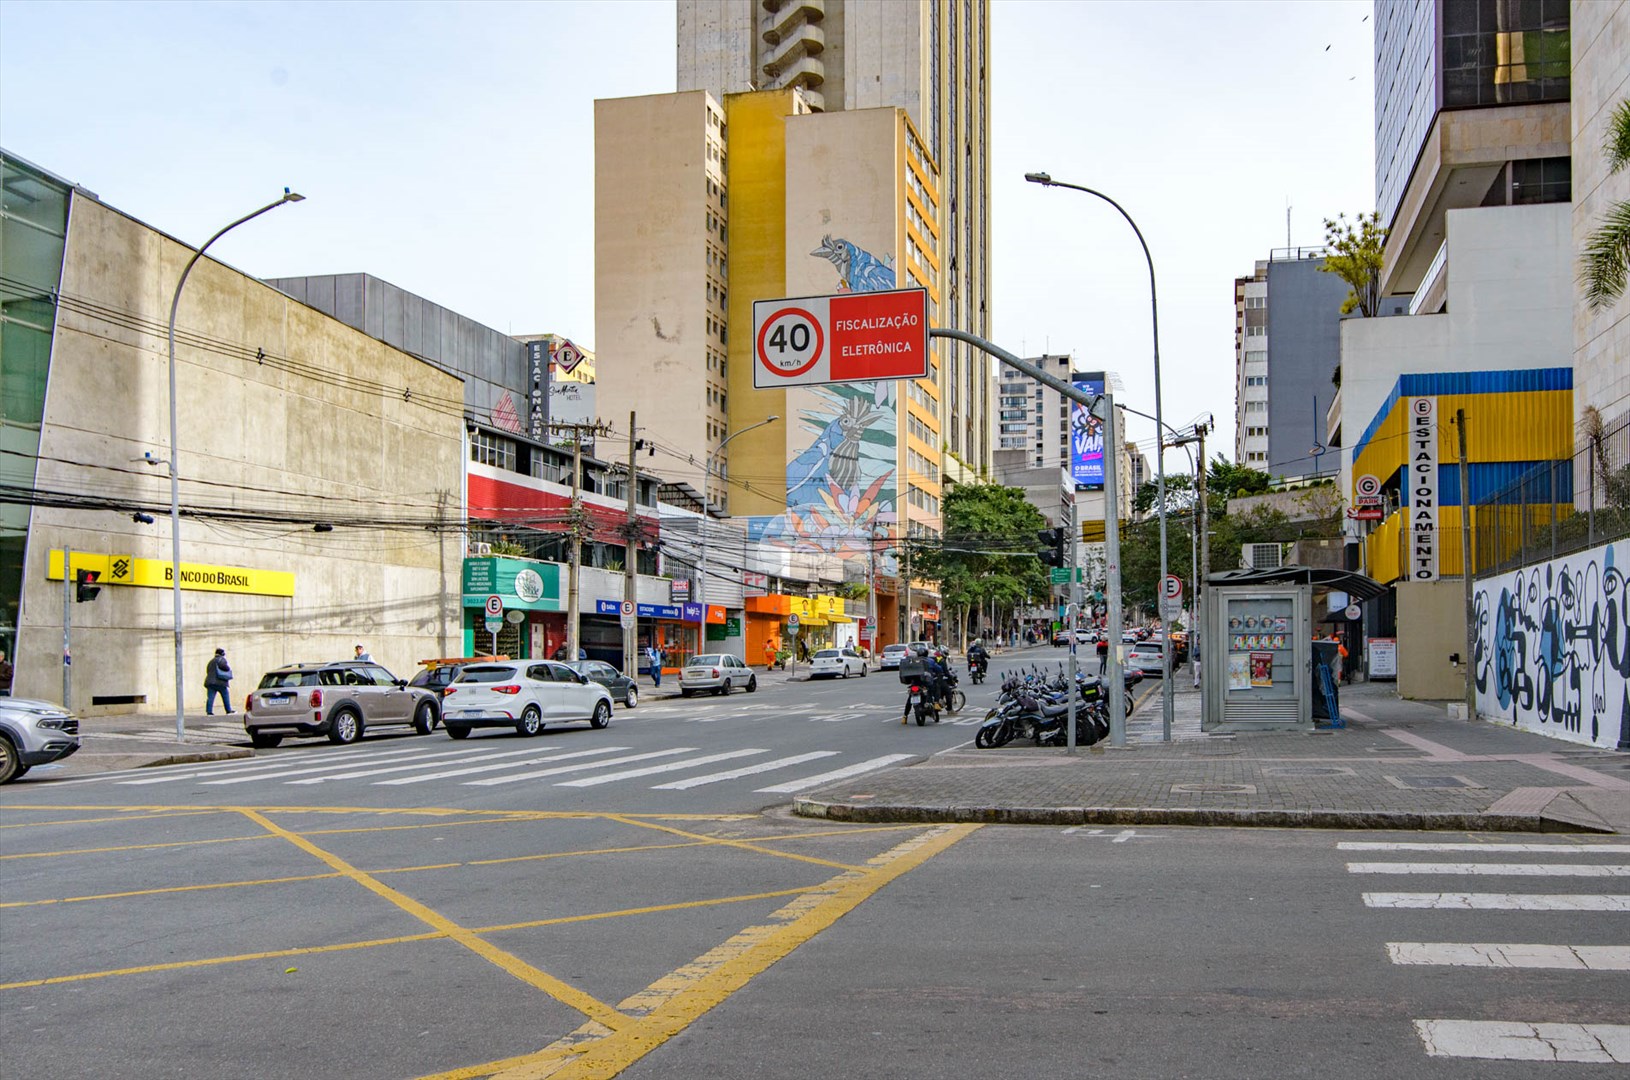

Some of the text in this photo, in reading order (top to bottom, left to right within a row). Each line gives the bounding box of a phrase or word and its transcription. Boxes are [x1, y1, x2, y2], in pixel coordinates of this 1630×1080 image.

[836, 312, 918, 331] FISCALIZAÇÃO
[769, 323, 810, 353] 40
[842, 340, 912, 357] ELETRÔNICA
[563, 350, 572, 361] E
[780, 358, 802, 367] km/h
[1418, 402, 1427, 412] E
[1362, 480, 1375, 492] G
[1415, 417, 1433, 579] ESTACIONAMENTO
[165, 567, 250, 587] BNCO DO BRASIL
[1167, 580, 1174, 592] E
[491, 599, 498, 610] E
[624, 603, 630, 612] E
